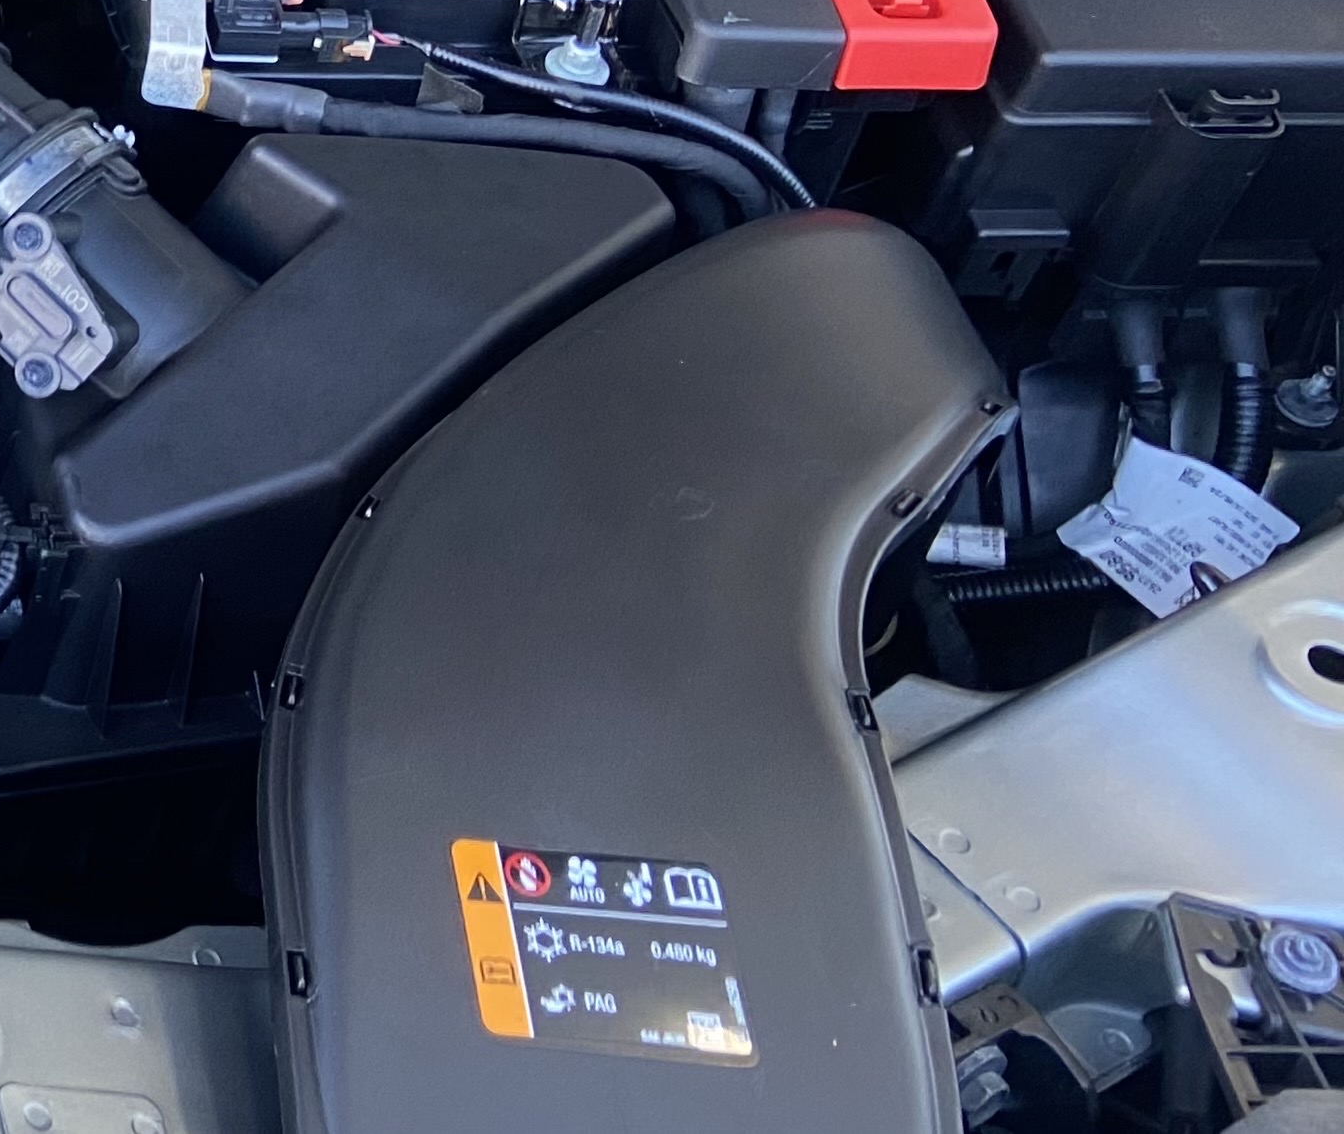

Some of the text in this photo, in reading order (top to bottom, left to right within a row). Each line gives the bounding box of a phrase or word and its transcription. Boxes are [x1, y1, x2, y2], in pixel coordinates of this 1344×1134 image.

[570, 886, 606, 904] AUTO
[569, 933, 626, 957] R-134a
[696, 945, 717, 968] kg
[583, 991, 617, 1014] PAG
